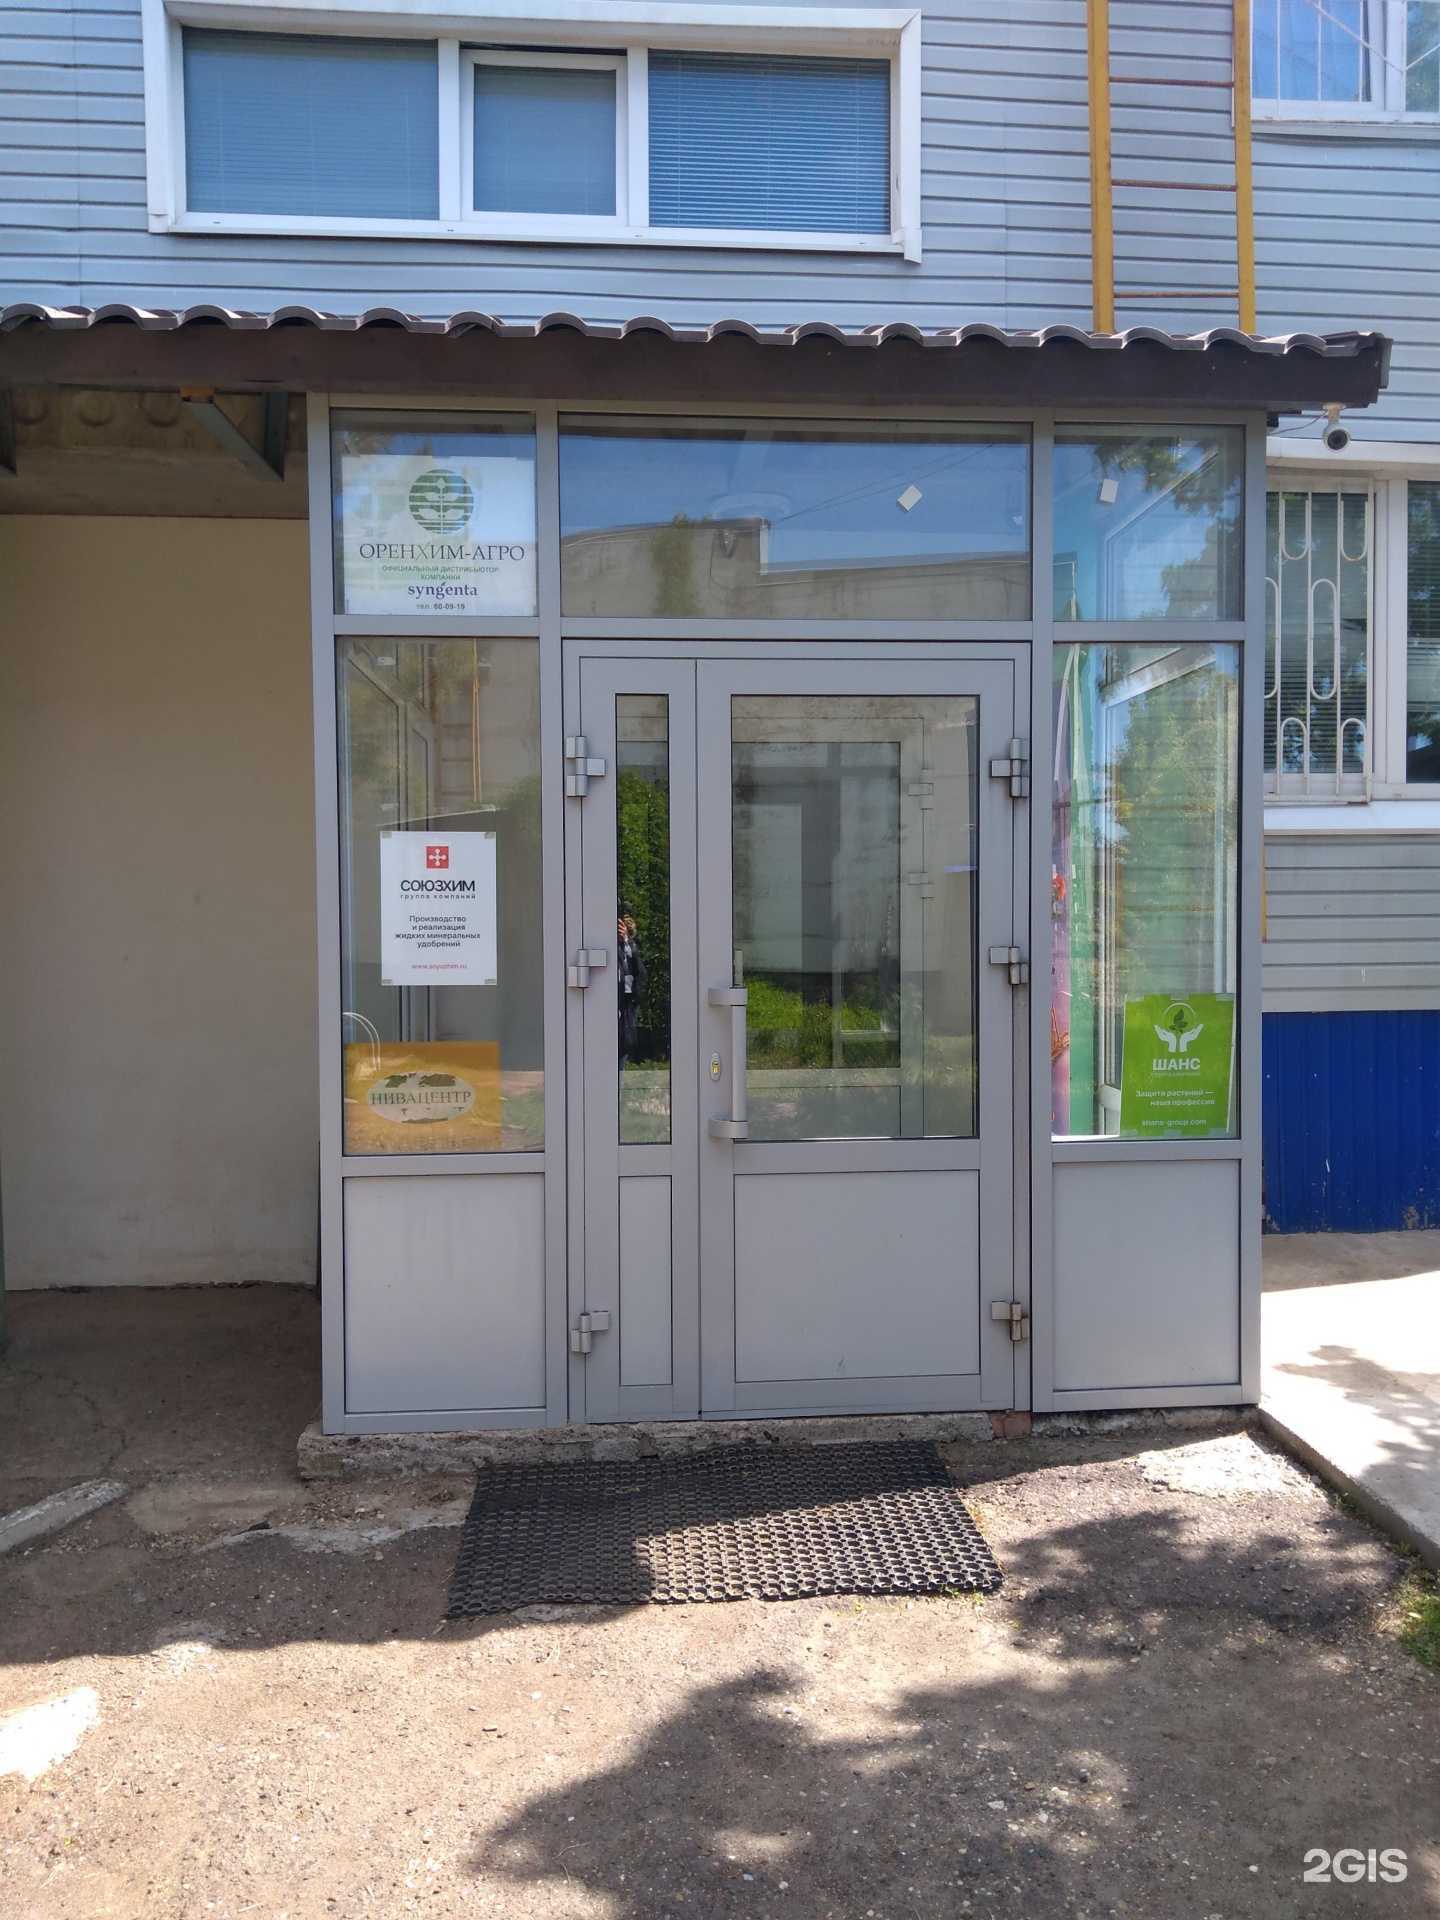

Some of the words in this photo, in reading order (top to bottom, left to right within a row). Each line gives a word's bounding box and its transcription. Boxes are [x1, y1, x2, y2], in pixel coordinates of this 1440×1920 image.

[359, 543, 525, 561] ОРЕНХИМ-АГРО
[407, 582, 478, 600] syngenta
[400, 879, 476, 892] СОЮЗХИМ
[408, 914, 467, 923] Производство
[417, 940, 461, 949] удобрений
[1152, 1058, 1201, 1071] ШАНС
[371, 1091, 472, 1105] НИВАЦЕНТР
